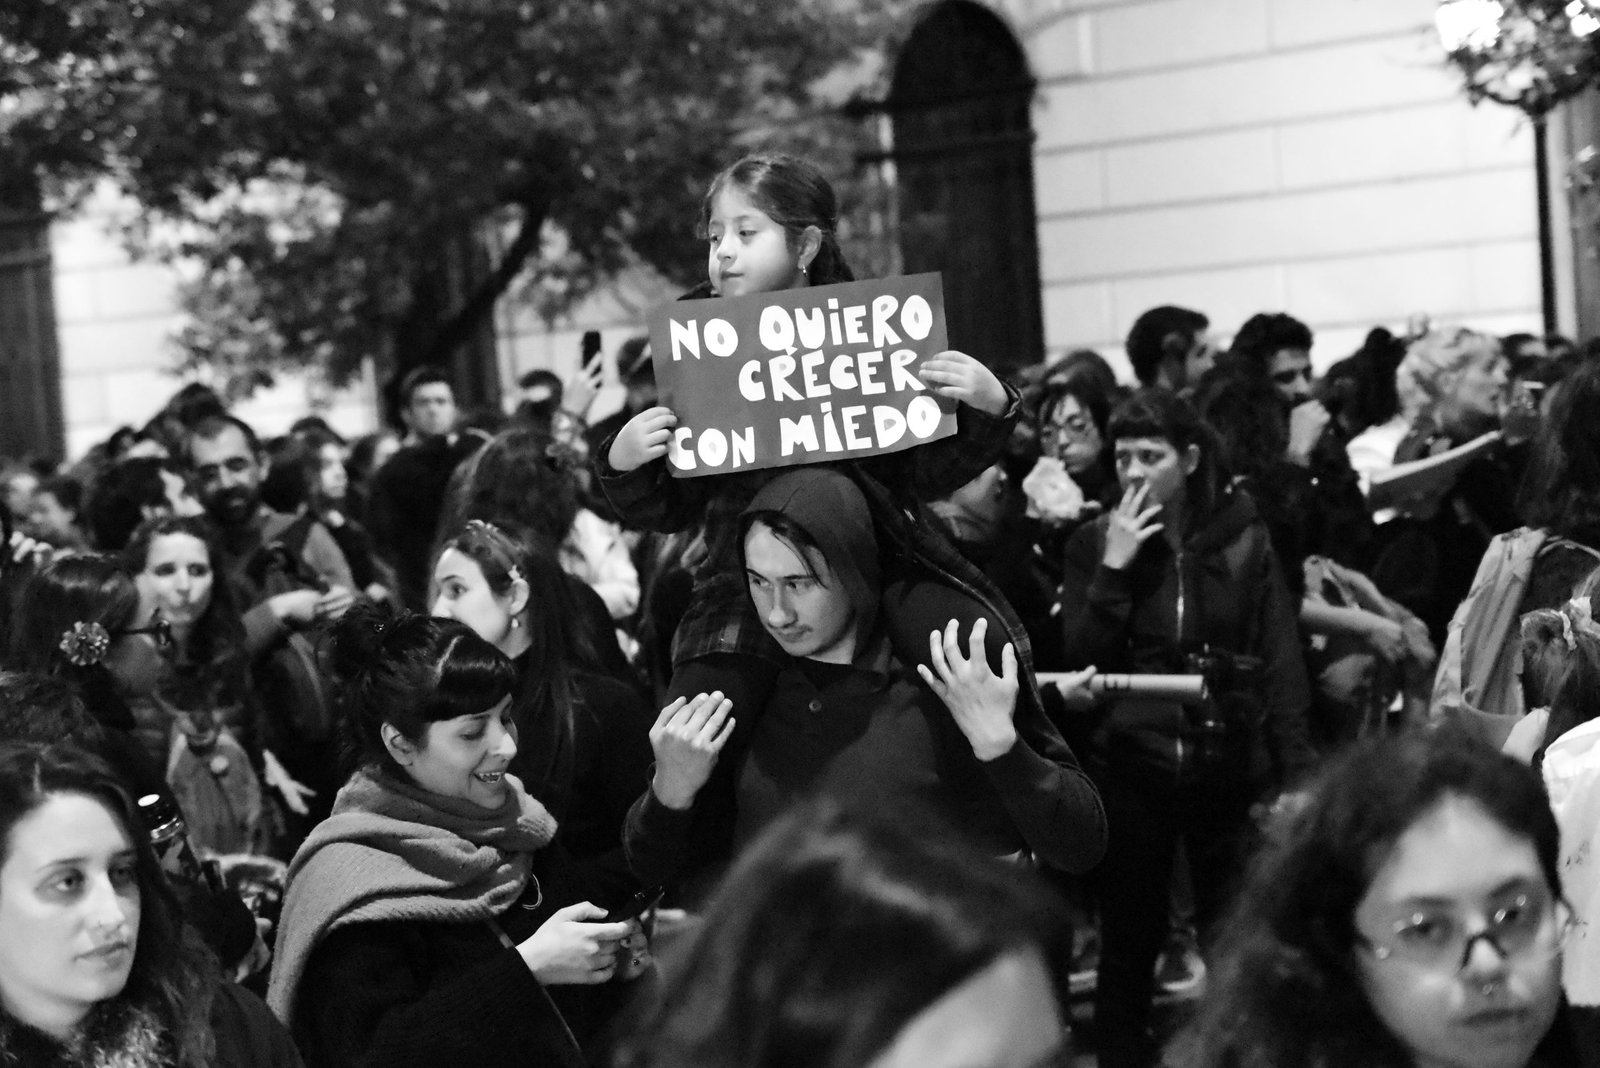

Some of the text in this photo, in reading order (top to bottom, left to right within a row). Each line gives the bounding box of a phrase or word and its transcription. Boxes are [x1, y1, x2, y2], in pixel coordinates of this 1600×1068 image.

[670, 318, 738, 361] NO
[738, 349, 926, 401] CRECER
[668, 426, 755, 470] CON
